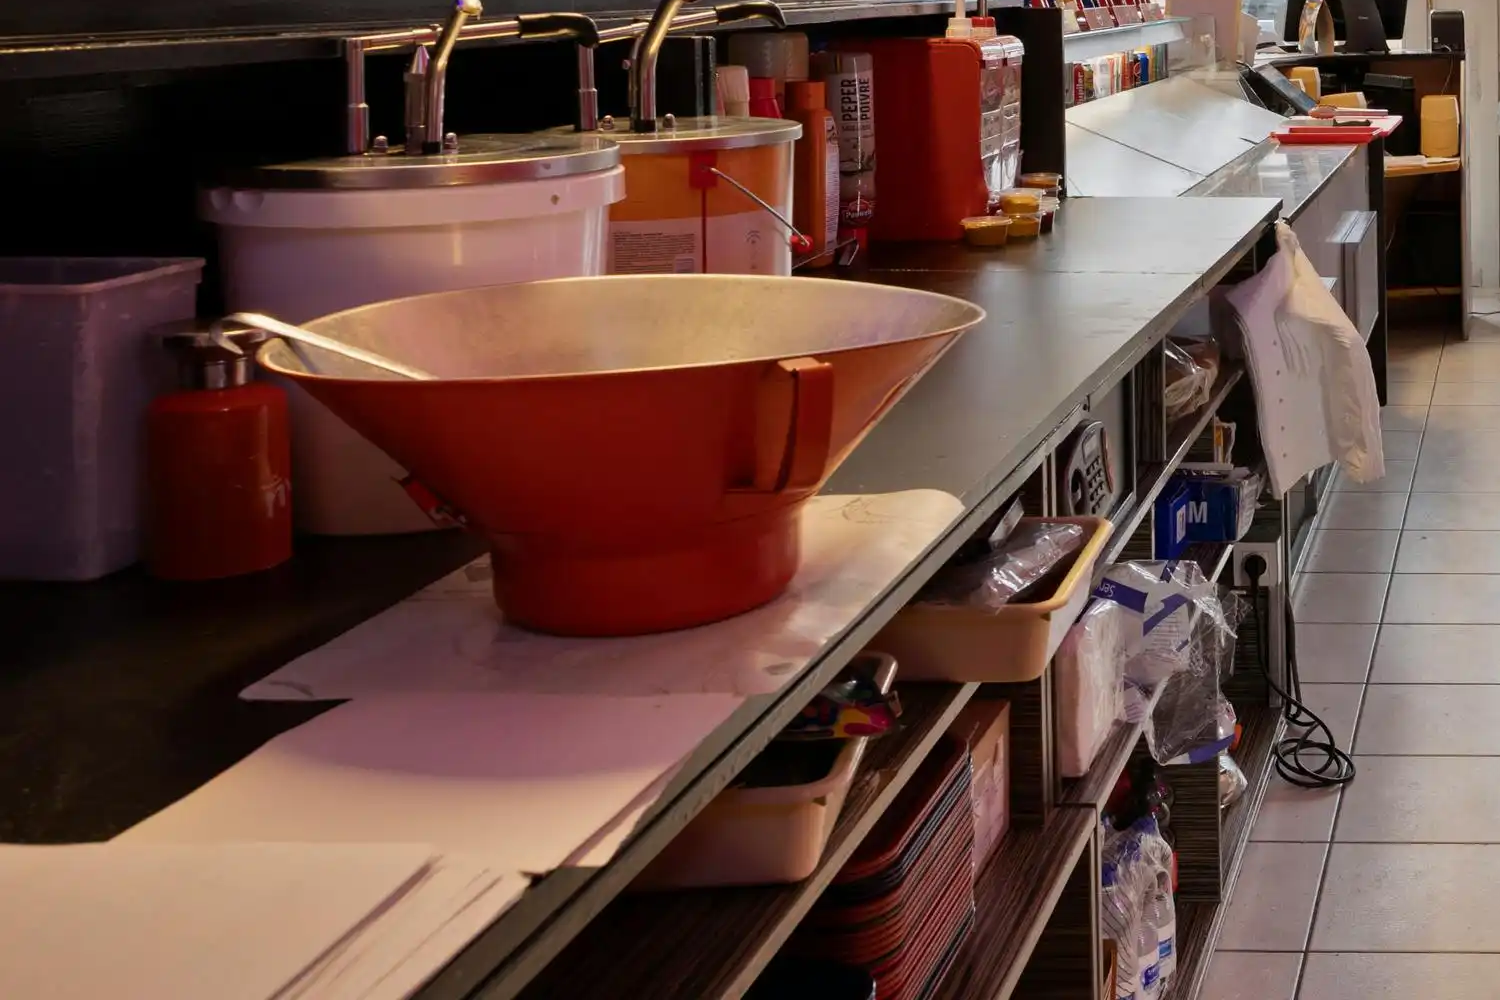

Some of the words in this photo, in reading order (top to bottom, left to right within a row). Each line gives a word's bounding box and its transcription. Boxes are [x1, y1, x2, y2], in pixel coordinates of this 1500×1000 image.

[841, 78, 858, 122] PEPER
[859, 77, 871, 120] POIVRE
[1188, 501, 1209, 524] M
